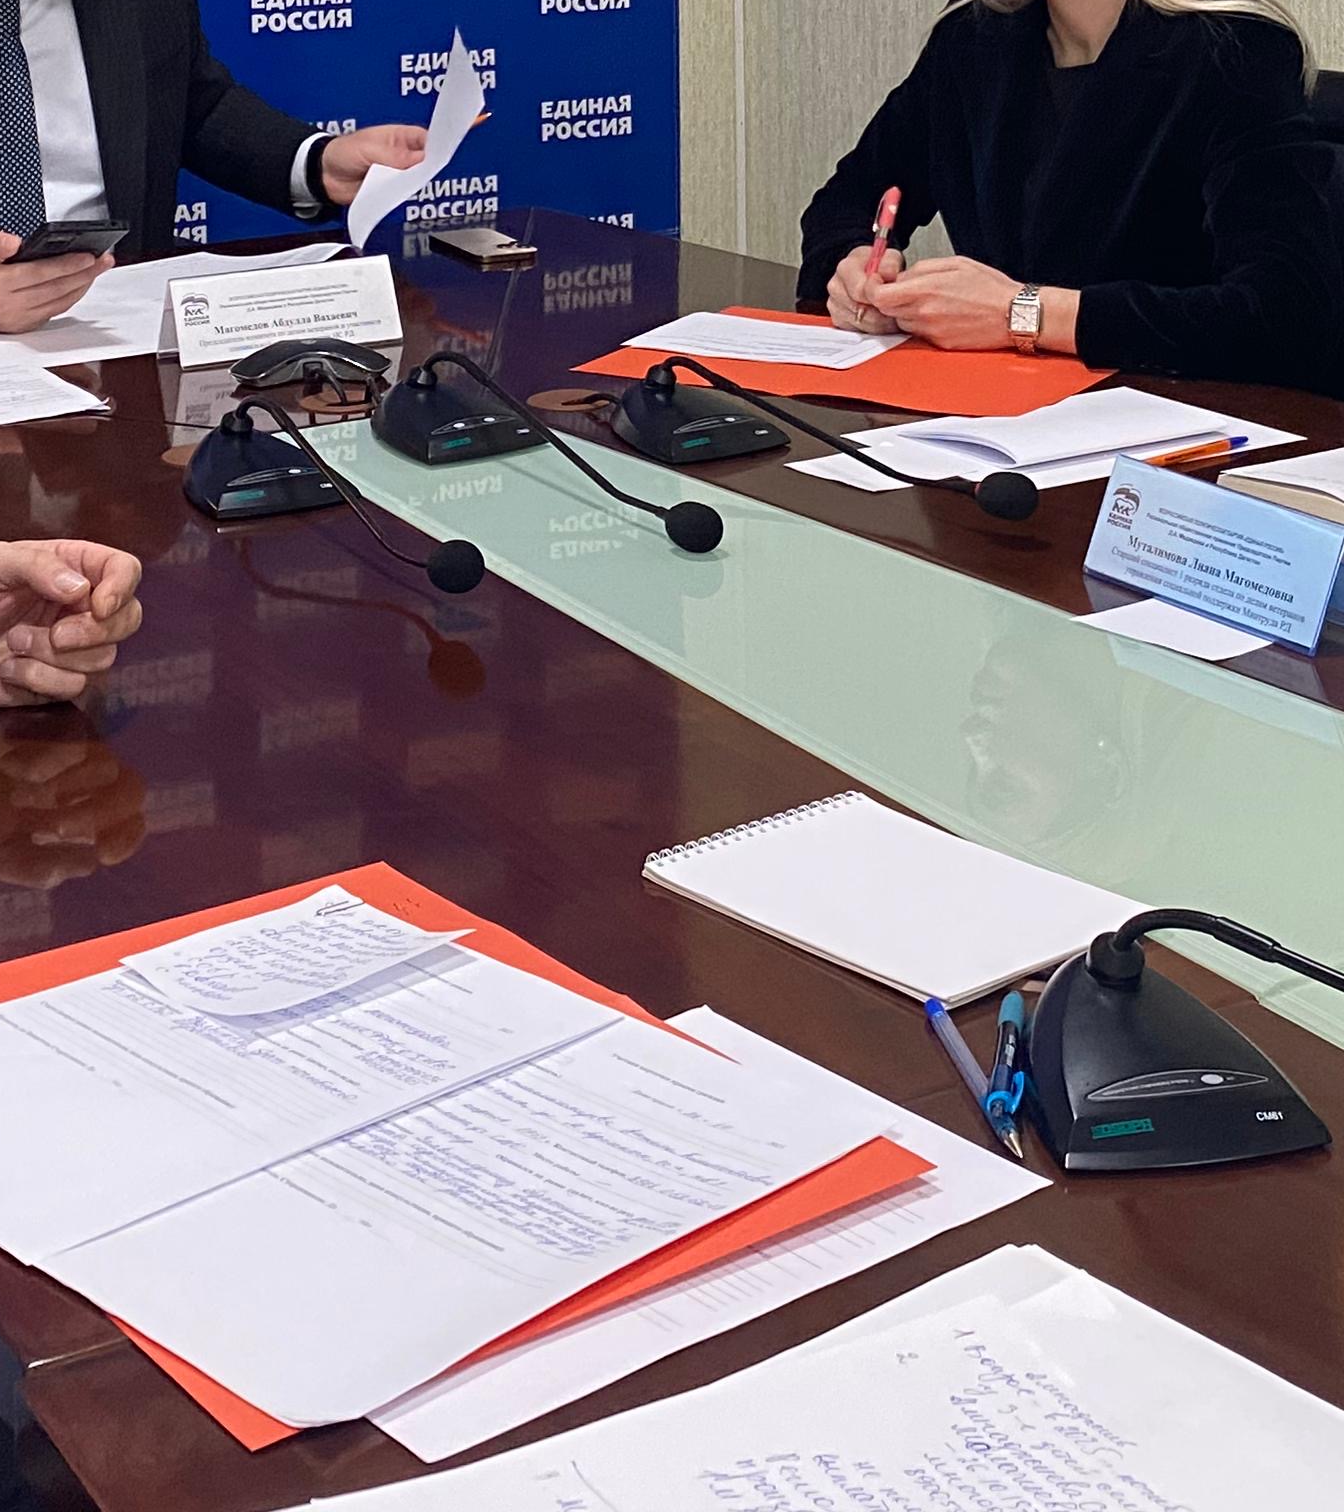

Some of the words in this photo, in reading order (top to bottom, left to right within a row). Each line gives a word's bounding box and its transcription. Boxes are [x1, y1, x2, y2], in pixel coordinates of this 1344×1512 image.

[252, 9, 352, 33] РОССИЯ
[1128, 535, 1188, 566] Муталимова
[1224, 569, 1294, 603] Магомедовна
